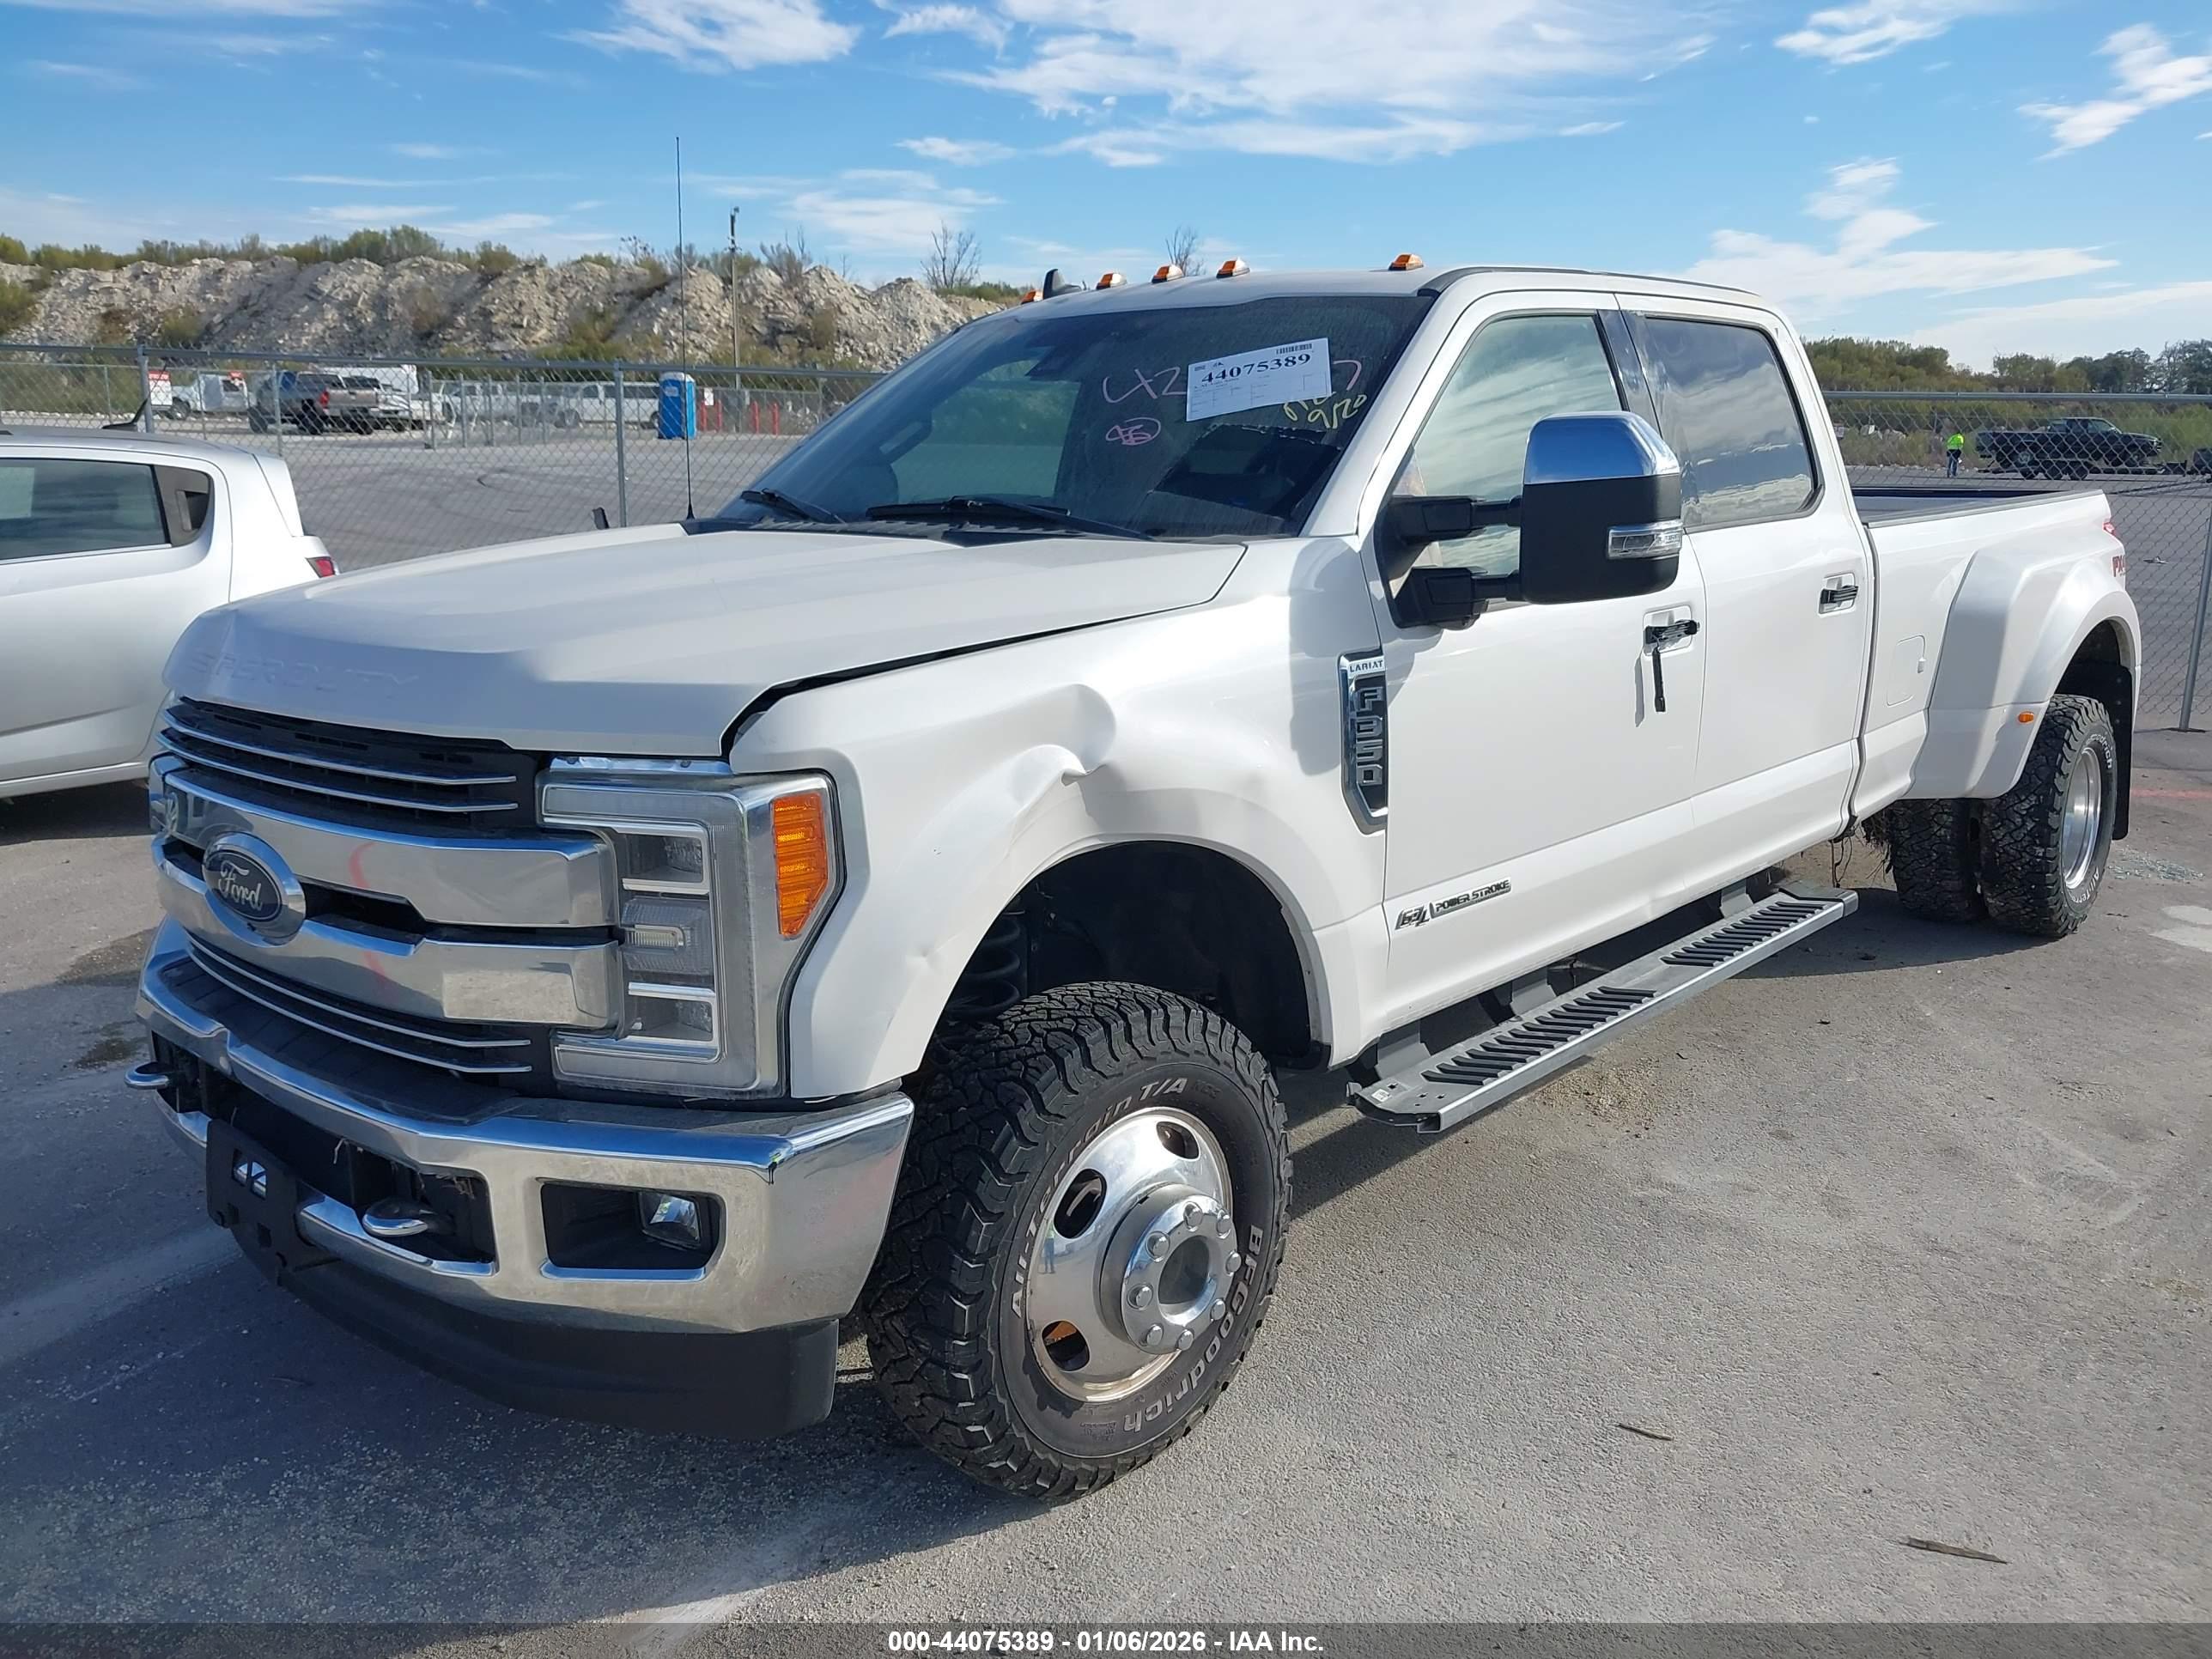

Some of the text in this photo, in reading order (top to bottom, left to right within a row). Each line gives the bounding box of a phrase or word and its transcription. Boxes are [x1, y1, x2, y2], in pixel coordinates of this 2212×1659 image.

[1202, 353, 1310, 383] 44075389
[1349, 659, 1384, 673] LARIAT
[217, 860, 263, 911] Ford
[1435, 893, 1470, 912] POWER
[1471, 879, 1510, 900] STROKE
[1140, 1078, 1188, 1102] T/A
[1123, 1224, 1264, 1432] BFGoodrich
